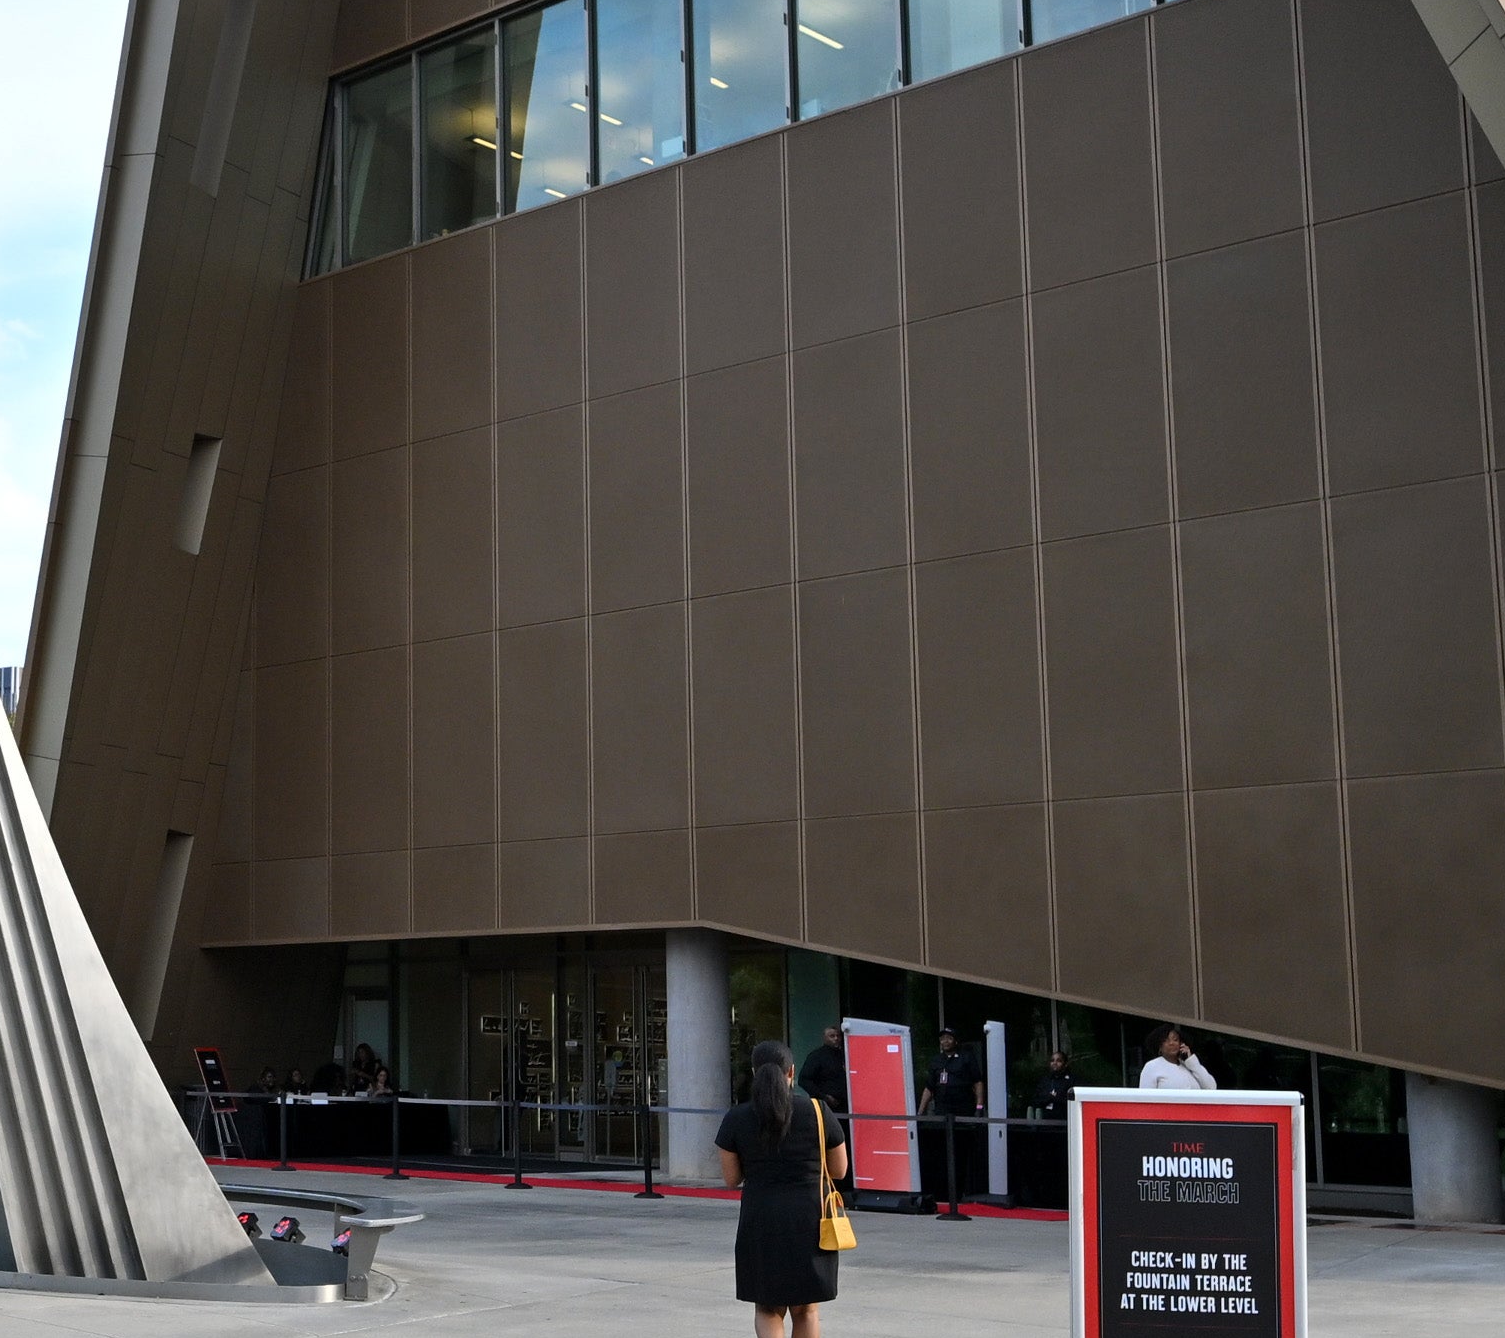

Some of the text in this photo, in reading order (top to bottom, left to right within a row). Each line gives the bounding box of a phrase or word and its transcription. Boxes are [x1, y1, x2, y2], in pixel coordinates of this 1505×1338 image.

[1171, 1142, 1205, 1153] TIME
[1142, 1156, 1234, 1179] HONORING
[1138, 1180, 1239, 1204] THE MARCH
[1131, 1250, 1247, 1270] CHECK-IN BY THE
[1127, 1272, 1252, 1292] FOUNTAIN TERRACE
[1120, 1293, 1258, 1314] AT THE LOWER LEVEL
